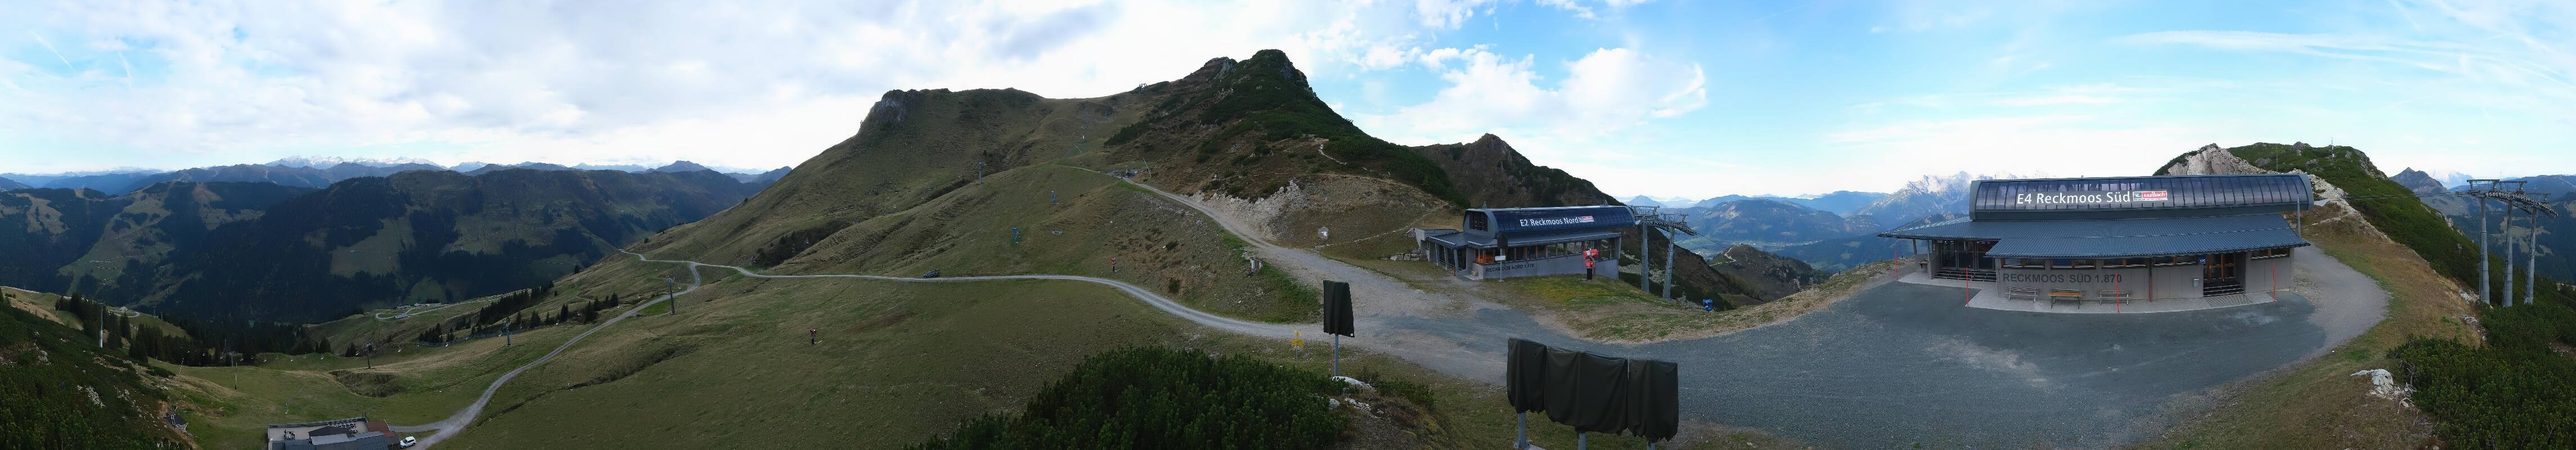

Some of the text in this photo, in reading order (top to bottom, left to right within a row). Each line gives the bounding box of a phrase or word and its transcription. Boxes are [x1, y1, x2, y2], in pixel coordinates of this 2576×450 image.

[2017, 191, 2130, 204] E4 Reckmoos Süd
[1530, 217, 1563, 226] Reckmoos
[2003, 273, 2122, 283] RECKMOOS SÜD 1.870
